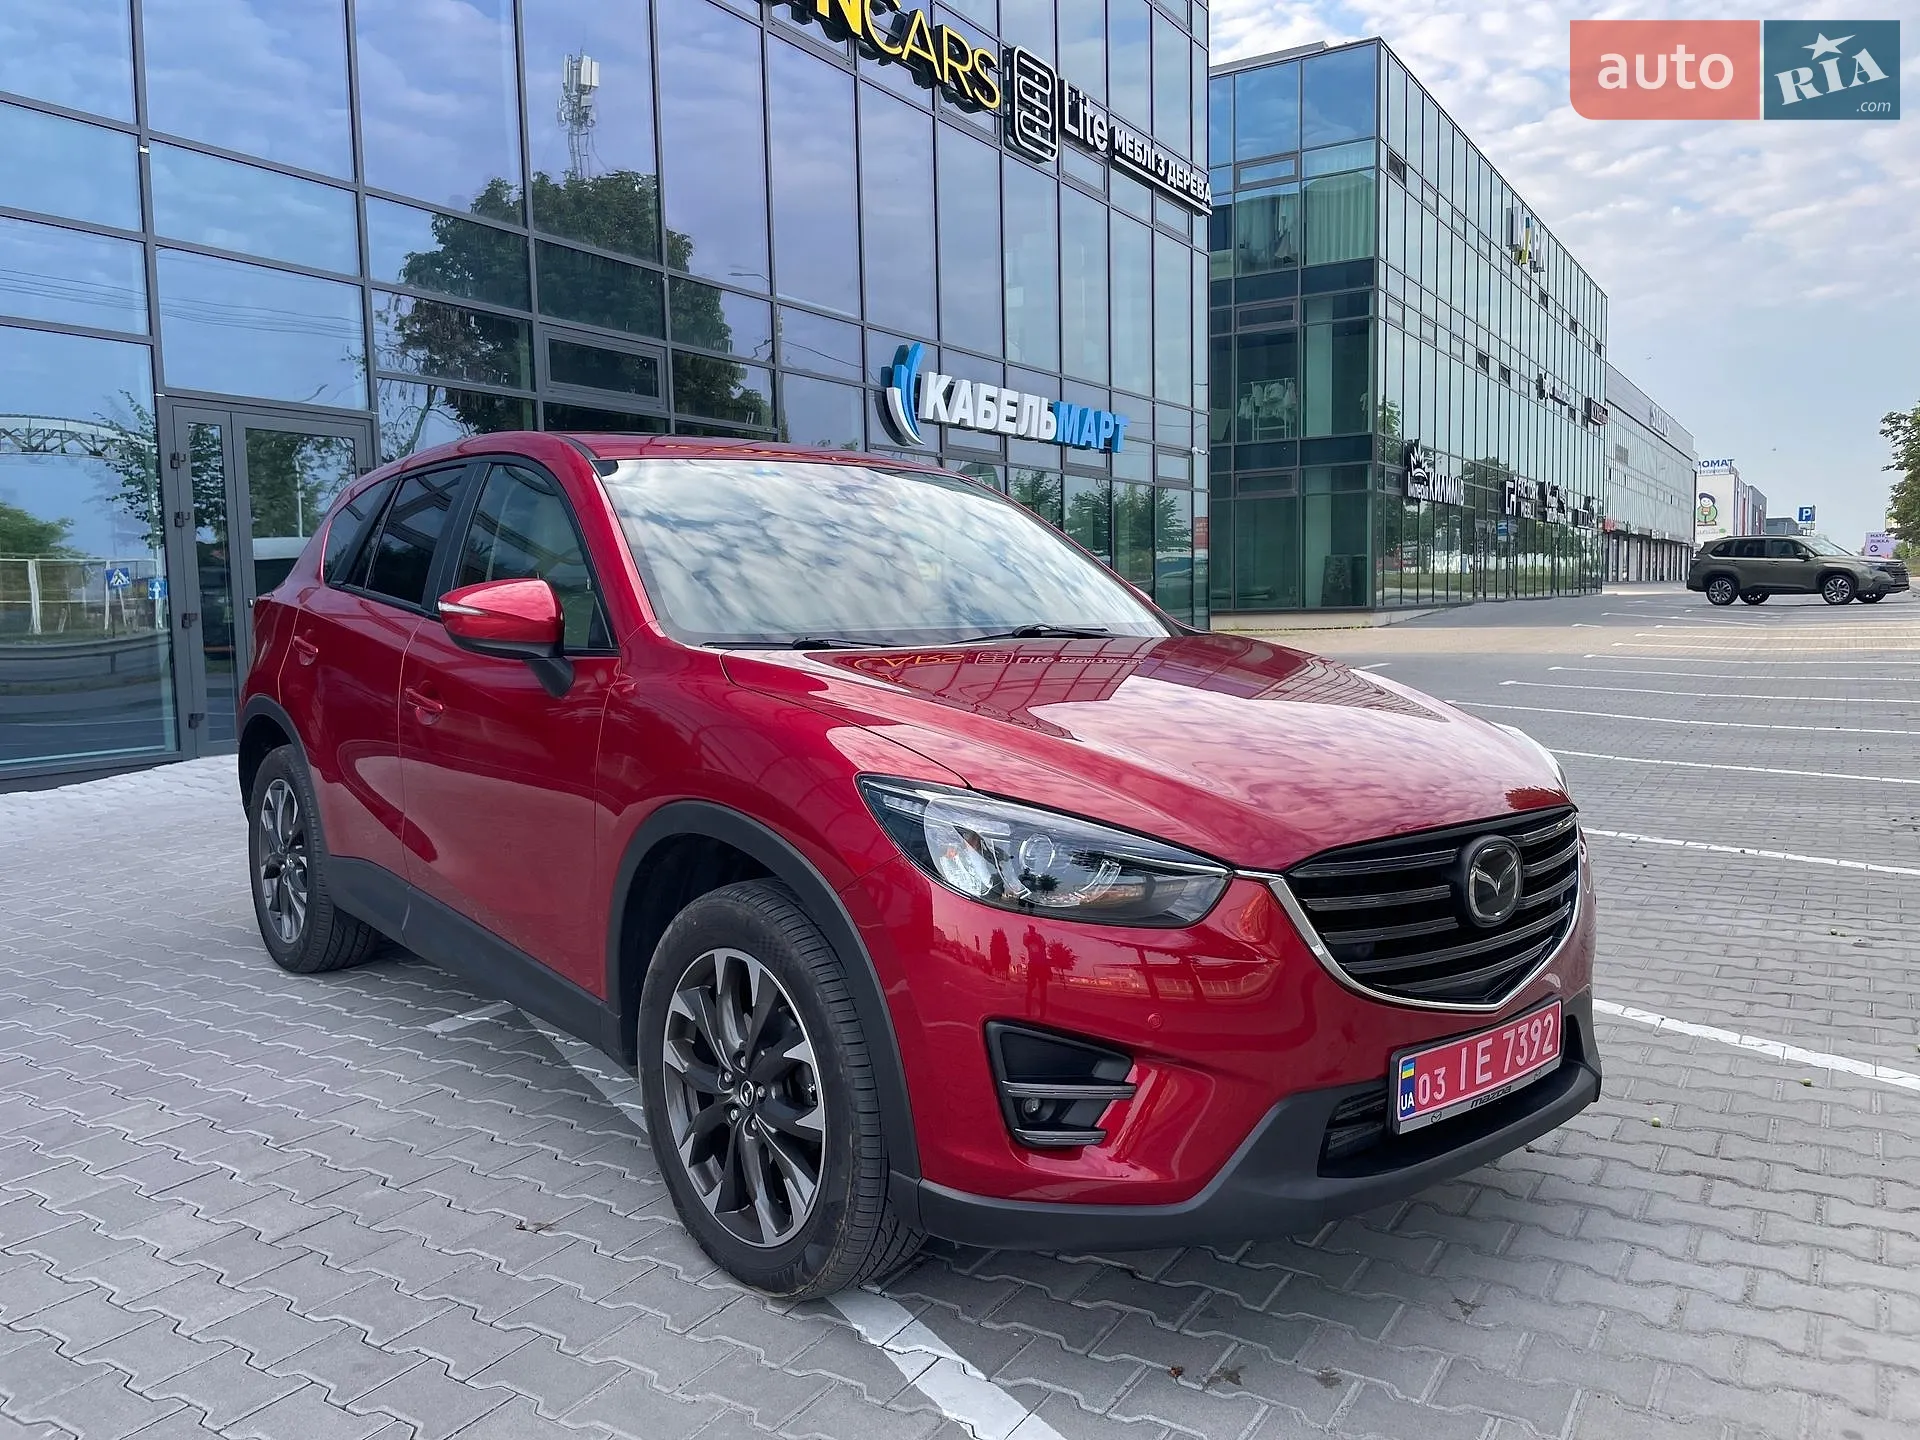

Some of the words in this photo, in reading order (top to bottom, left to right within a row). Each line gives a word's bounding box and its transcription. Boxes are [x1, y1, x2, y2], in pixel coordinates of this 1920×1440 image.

[1064, 79, 1108, 152] Lite
[1114, 125, 1156, 172] МЕБЛІ
[1167, 159, 1213, 206] ДЕРЕВА
[918, 371, 1129, 454] КАБЕЛЬМАРТ
[1418, 1066, 1446, 1106] 03
[1459, 1038, 1493, 1091] IE
[1502, 1012, 1555, 1074] 7392
[1400, 1093, 1415, 1111] UA
